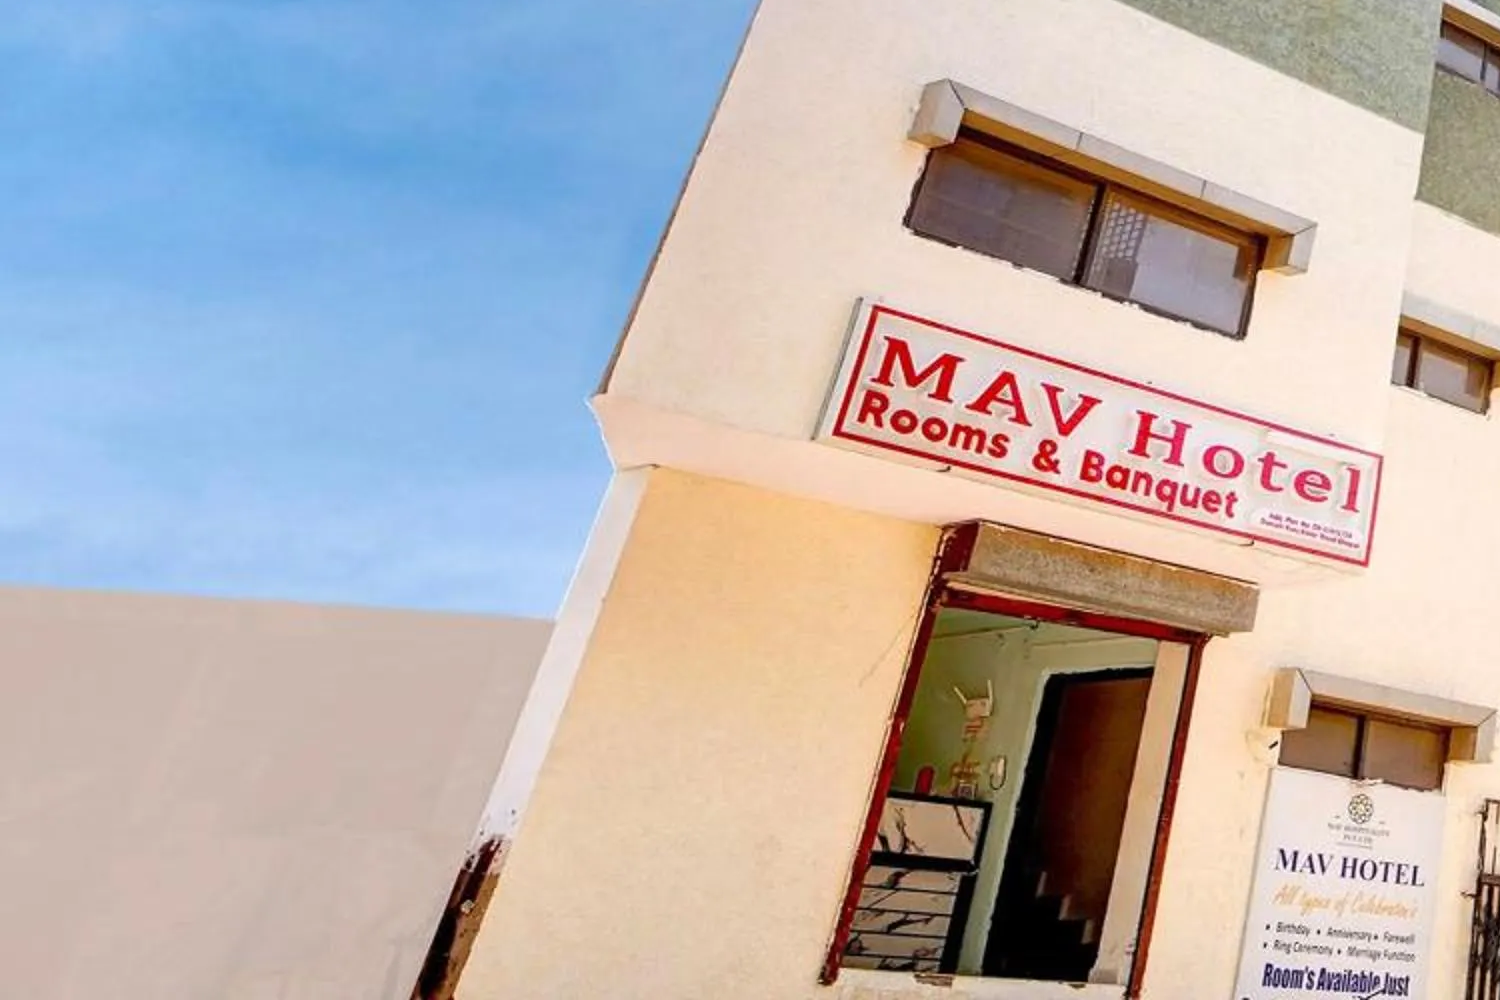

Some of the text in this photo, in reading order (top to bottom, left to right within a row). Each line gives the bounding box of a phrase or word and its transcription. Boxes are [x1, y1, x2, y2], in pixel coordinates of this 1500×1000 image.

[870, 335, 1362, 514] MAV Hotel
[856, 390, 1239, 518] Rooms & Banquet
[1274, 848, 1425, 887] MAV HOTEL
[1273, 939, 1291, 955] Ring
[1293, 941, 1333, 956] Ceremony
[1383, 949, 1416, 963] Function
[1275, 921, 1310, 937] Birthday
[1383, 931, 1416, 945] Farewell
[1262, 963, 1410, 997] Room's Available Just
